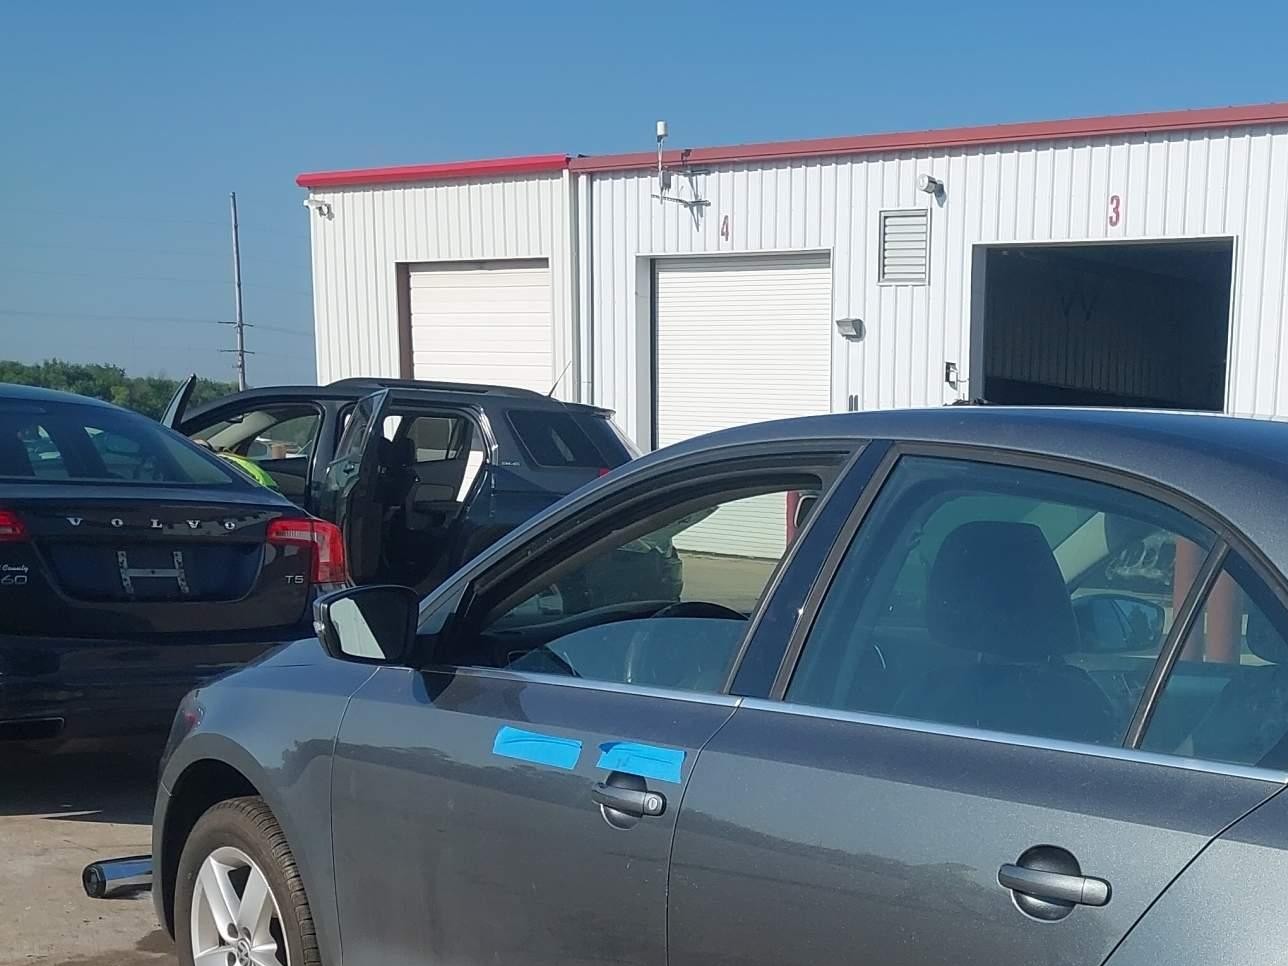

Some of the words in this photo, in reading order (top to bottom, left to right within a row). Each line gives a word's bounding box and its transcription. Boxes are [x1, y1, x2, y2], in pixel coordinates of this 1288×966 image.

[1108, 194, 1121, 227] 3
[720, 215, 730, 242] 4
[66, 517, 237, 530] VOLVO
[284, 575, 305, 584] T5
